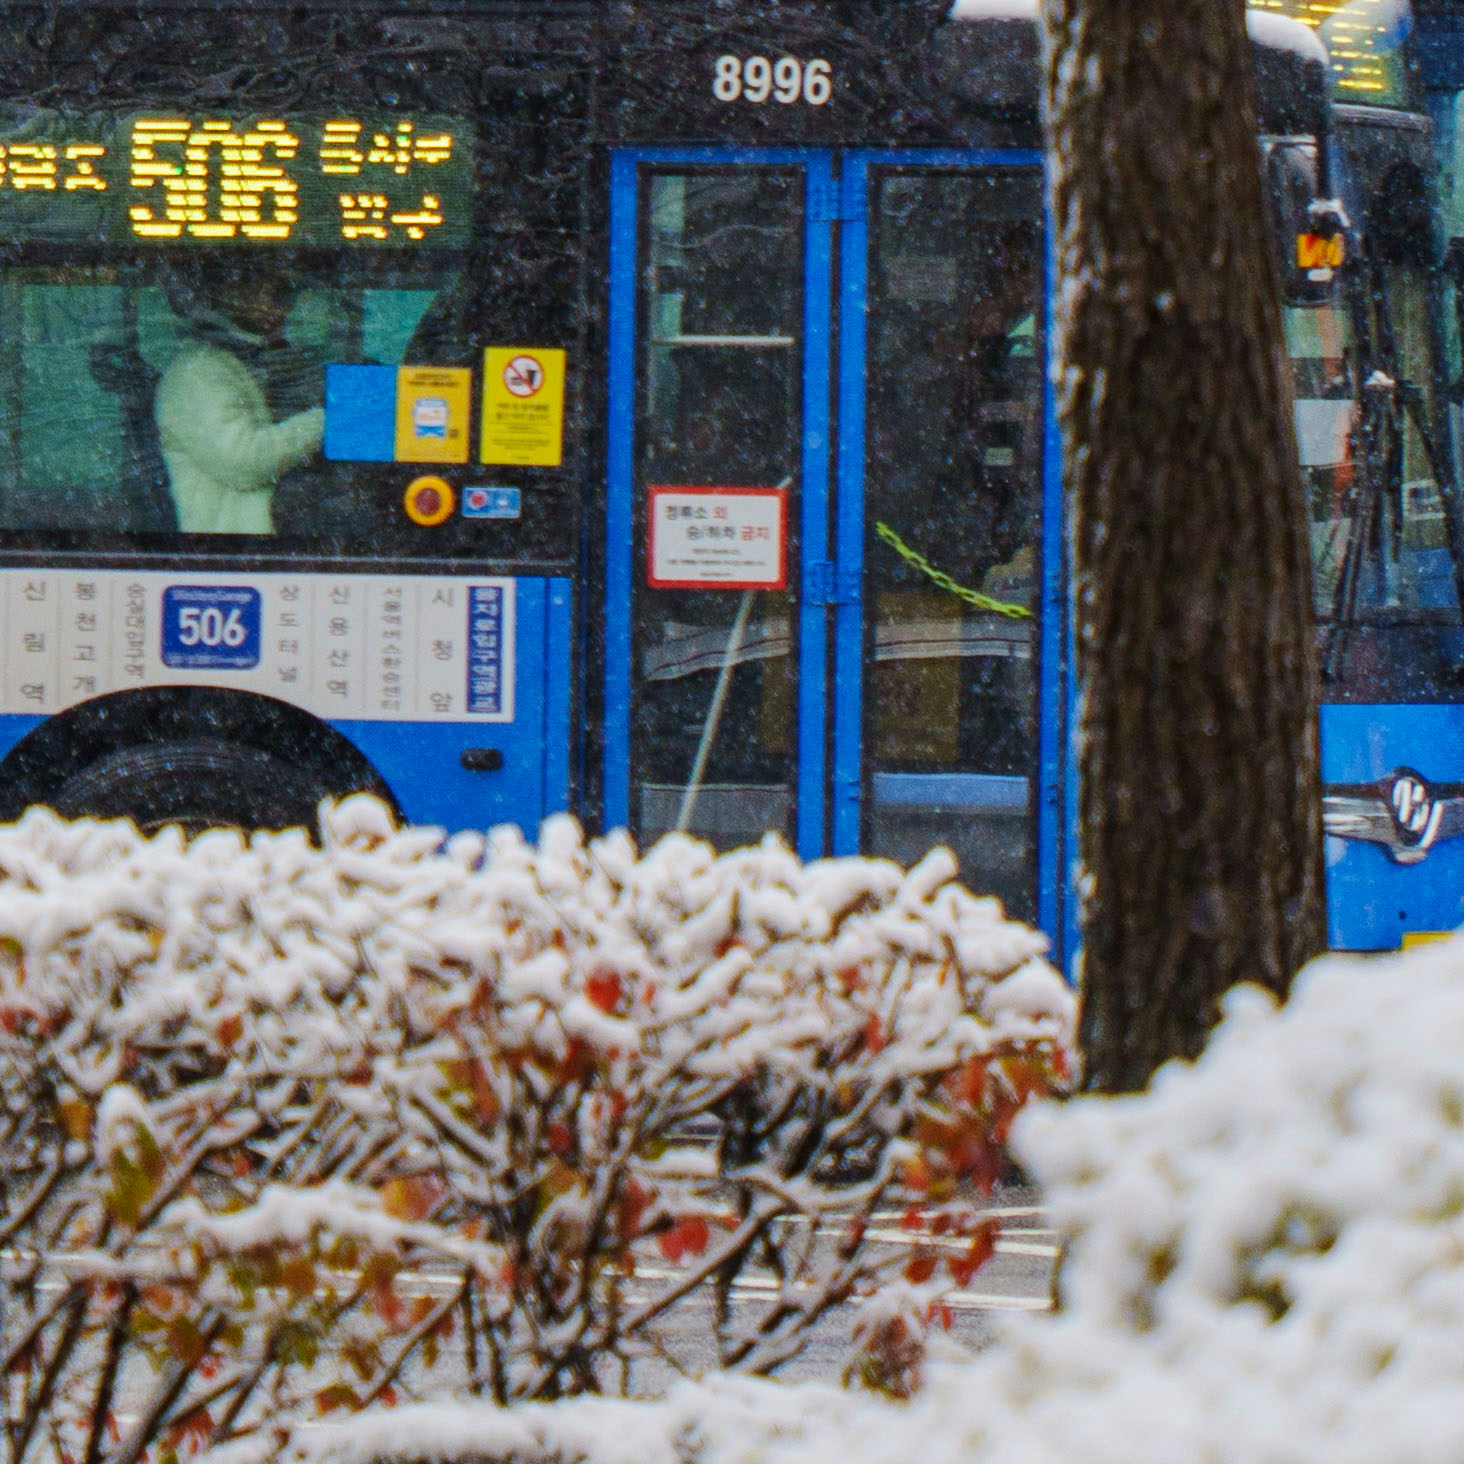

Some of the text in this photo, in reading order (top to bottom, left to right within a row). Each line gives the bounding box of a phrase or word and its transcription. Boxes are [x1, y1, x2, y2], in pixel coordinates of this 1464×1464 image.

[713, 54, 833, 105] 8996
[129, 119, 299, 239] 506
[665, 505, 708, 521] 정류소
[740, 525, 770, 541] 금지
[21, 581, 47, 704] 신림역
[73, 582, 97, 693] 봉천고개
[178, 607, 247, 647] 506
[278, 585, 300, 684] 상도터널
[326, 585, 351, 699] 신용산역
[430, 587, 454, 713] 시청앞
